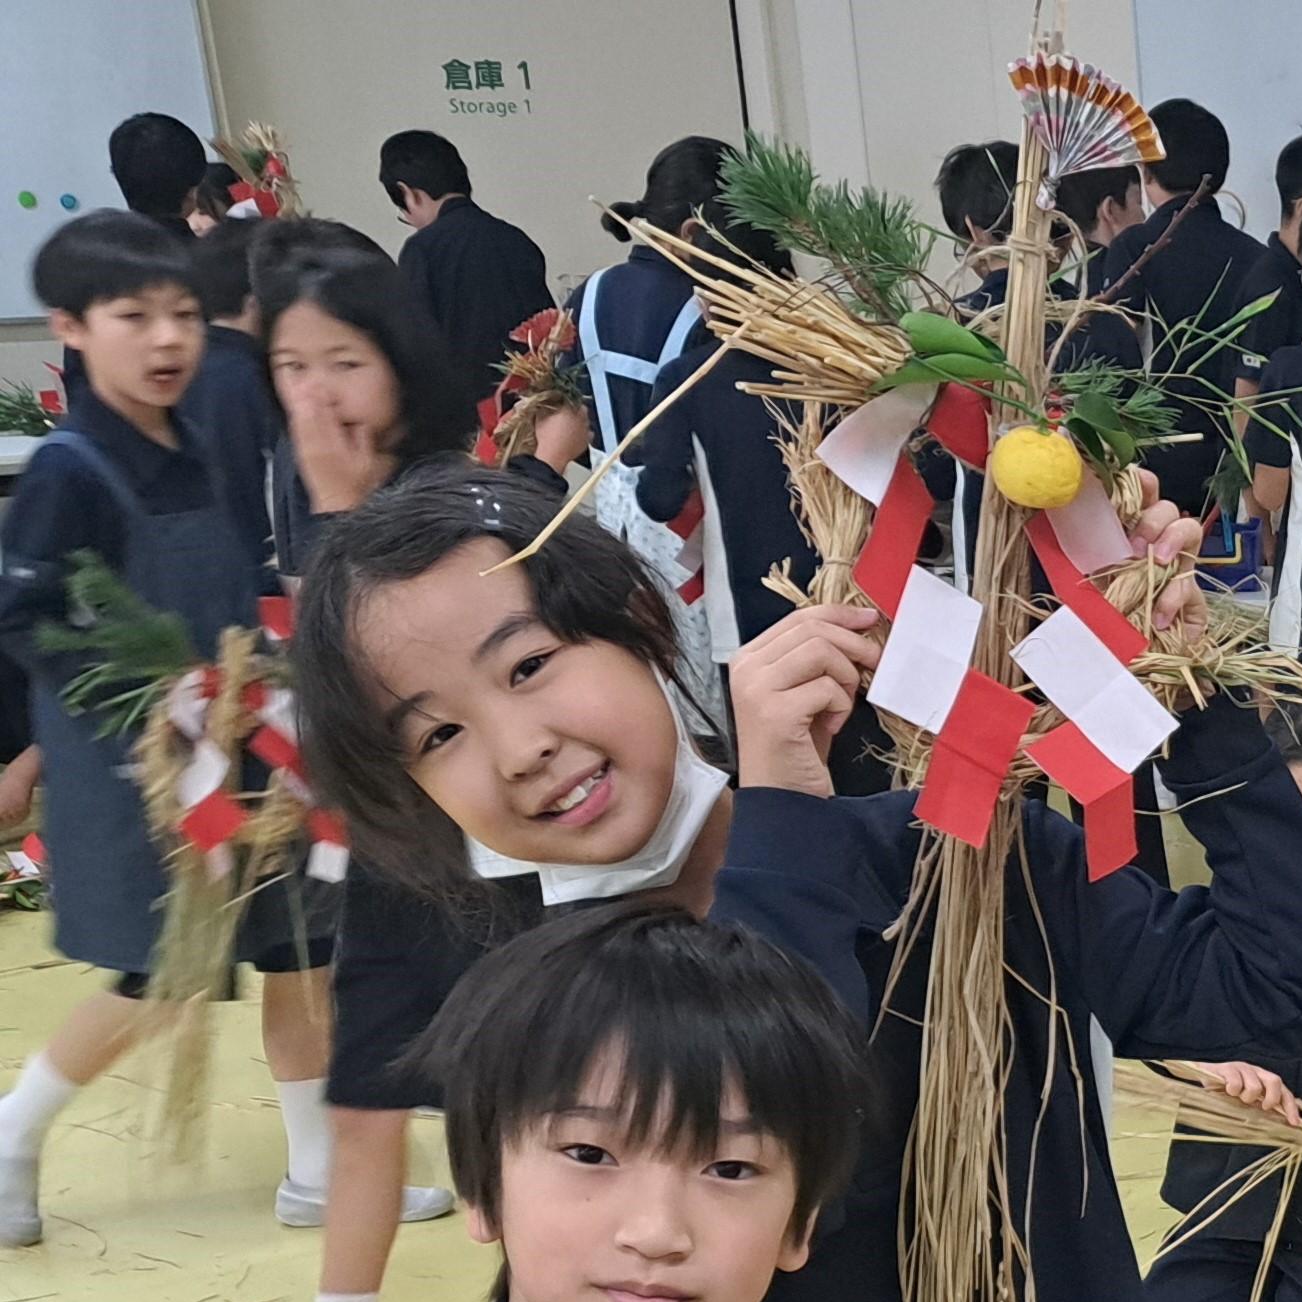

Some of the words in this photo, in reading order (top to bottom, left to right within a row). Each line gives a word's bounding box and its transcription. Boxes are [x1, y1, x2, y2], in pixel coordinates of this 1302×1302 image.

[441, 58, 505, 91] 倉庫
[516, 60, 531, 90] 1
[449, 97, 518, 118] Storage
[523, 98, 532, 114] 1
